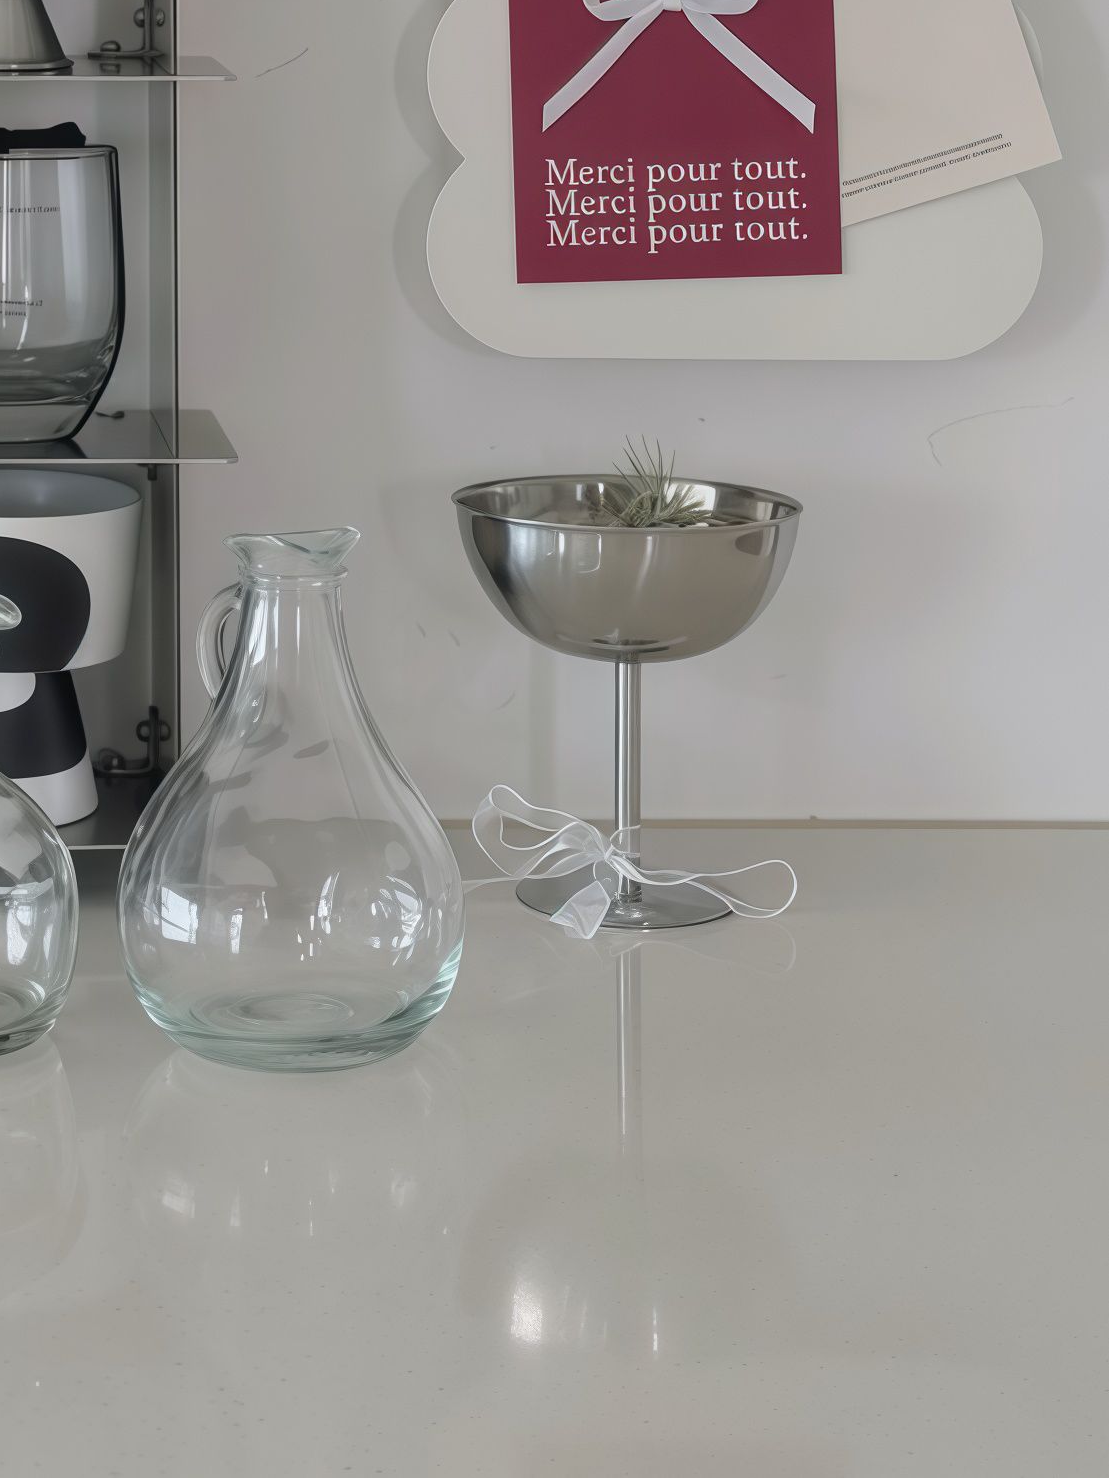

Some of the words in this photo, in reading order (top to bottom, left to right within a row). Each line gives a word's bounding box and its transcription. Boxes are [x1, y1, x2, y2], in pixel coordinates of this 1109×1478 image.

[545, 157, 635, 186] Merci
[647, 162, 722, 193] pour
[730, 157, 806, 181] tout.
[545, 186, 637, 217] Merci
[647, 192, 723, 223] pour
[732, 187, 808, 211] tout.
[546, 217, 638, 247] Merci
[648, 223, 724, 254] pour
[734, 217, 809, 242] tout.
